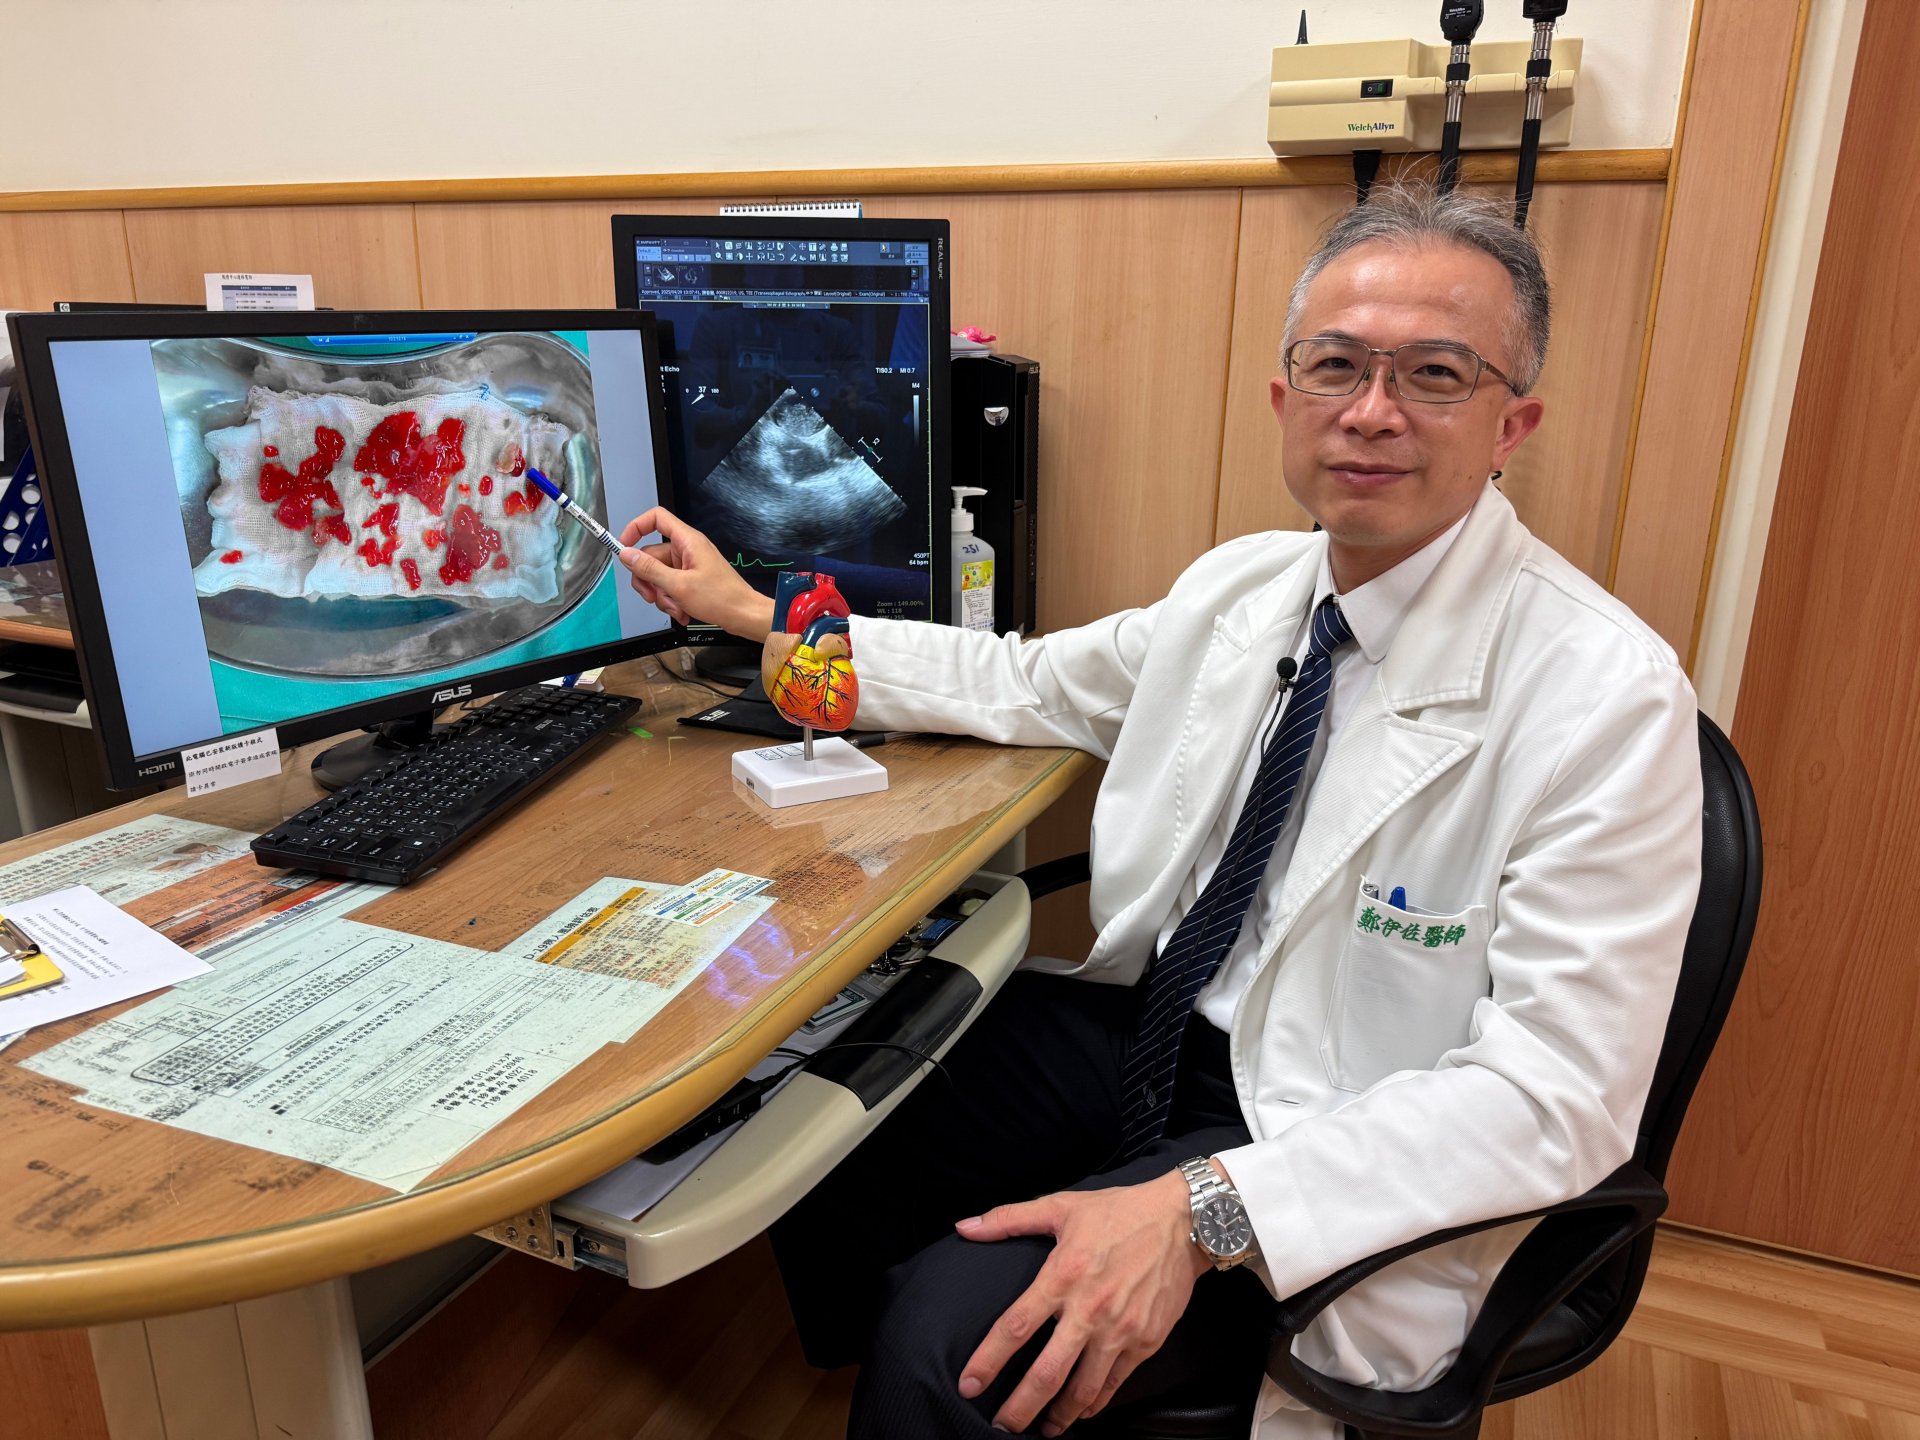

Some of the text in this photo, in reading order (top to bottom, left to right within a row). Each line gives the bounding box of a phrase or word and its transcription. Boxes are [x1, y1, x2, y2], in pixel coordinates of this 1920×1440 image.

[698, 385, 707, 393] 37
[962, 543, 980, 554] 251
[916, 559, 929, 567] bpm
[431, 684, 473, 704] ASUS
[535, 719, 554, 731] ASUS
[138, 761, 176, 777] HDMI
[1357, 905, 1467, 948] 鄭伊佐醫師
